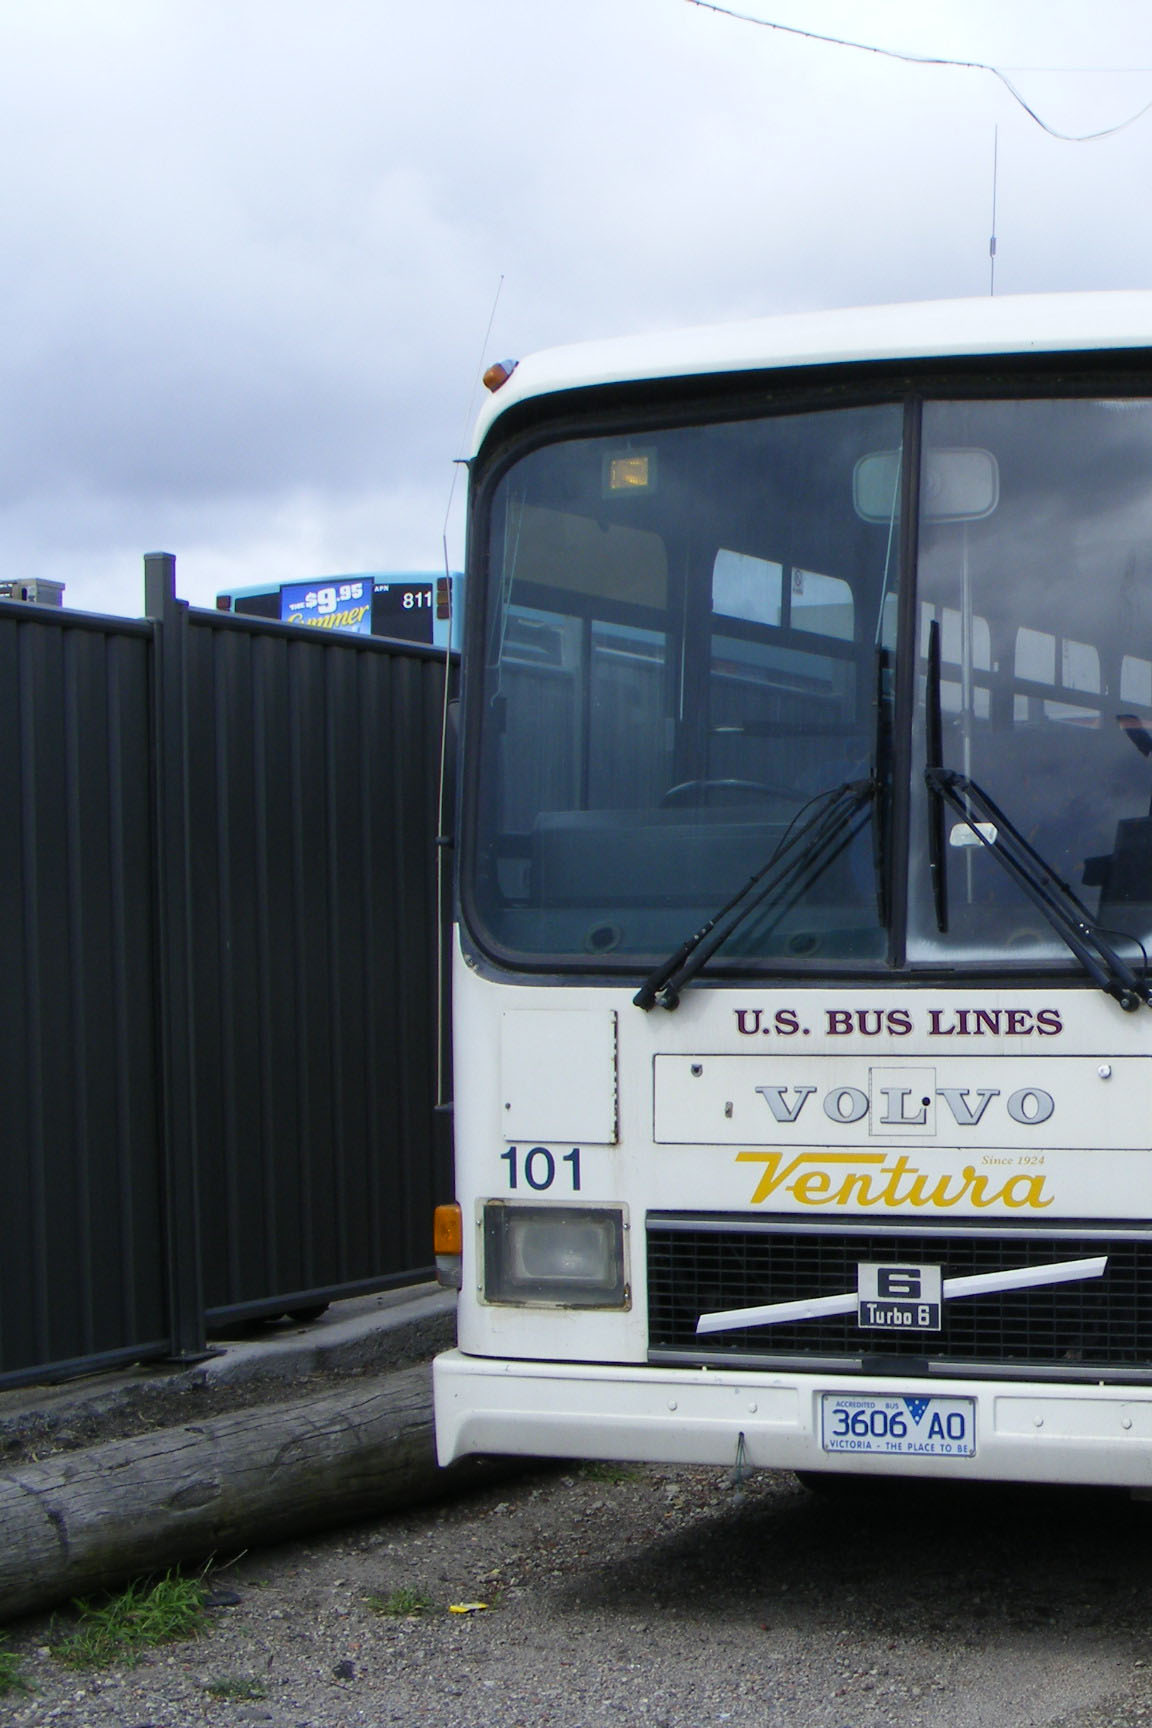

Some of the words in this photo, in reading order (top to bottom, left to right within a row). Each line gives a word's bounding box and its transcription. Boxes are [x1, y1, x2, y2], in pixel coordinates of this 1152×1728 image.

[305, 583, 363, 614] $9.95
[403, 591, 432, 608] 811
[734, 1009, 811, 1036] U.S.
[826, 1010, 913, 1036] BUS
[929, 1010, 1064, 1037] LINES
[755, 1086, 1055, 1125] VOLVO
[500, 1146, 581, 1191] 101
[981, 1155, 1014, 1166] Since
[1018, 1156, 1046, 1166] 1924
[734, 1151, 1055, 1208] Ventura
[877, 1268, 921, 1299] 6
[867, 1303, 912, 1325] Turbo
[918, 1305, 930, 1326] 6
[836, 1401, 876, 1409] ACCREDITED
[885, 1402, 899, 1410] BUS
[832, 1409, 907, 1438] 3606
[830, 1440, 872, 1449] VICTORIA
[886, 1442, 902, 1450] THE
[907, 1443, 935, 1451] PLACE
[940, 1444, 952, 1452] TO
[957, 1445, 968, 1453] BE
